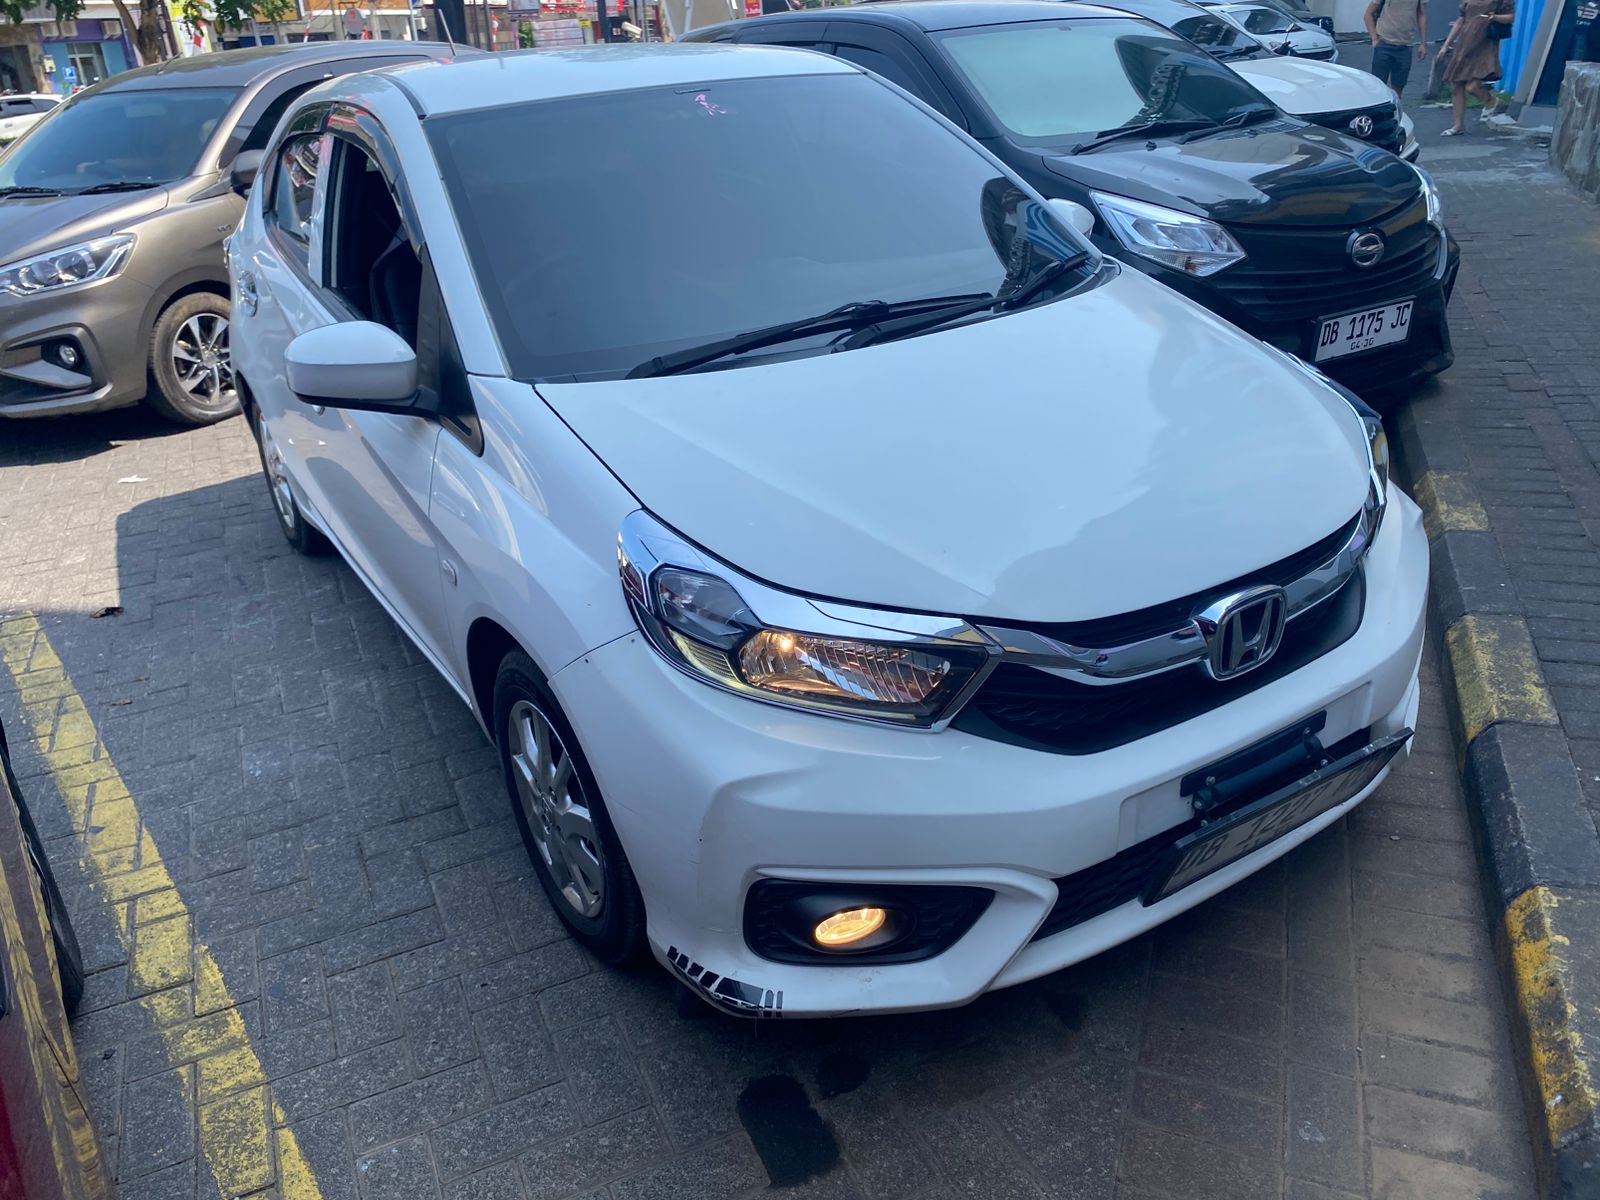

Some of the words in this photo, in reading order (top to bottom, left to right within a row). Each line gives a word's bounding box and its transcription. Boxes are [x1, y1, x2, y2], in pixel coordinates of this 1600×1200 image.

[1320, 320, 1340, 347] DB
[1346, 310, 1385, 341] 1175
[1391, 303, 1411, 329] JC
[1237, 782, 1331, 847] 1227
